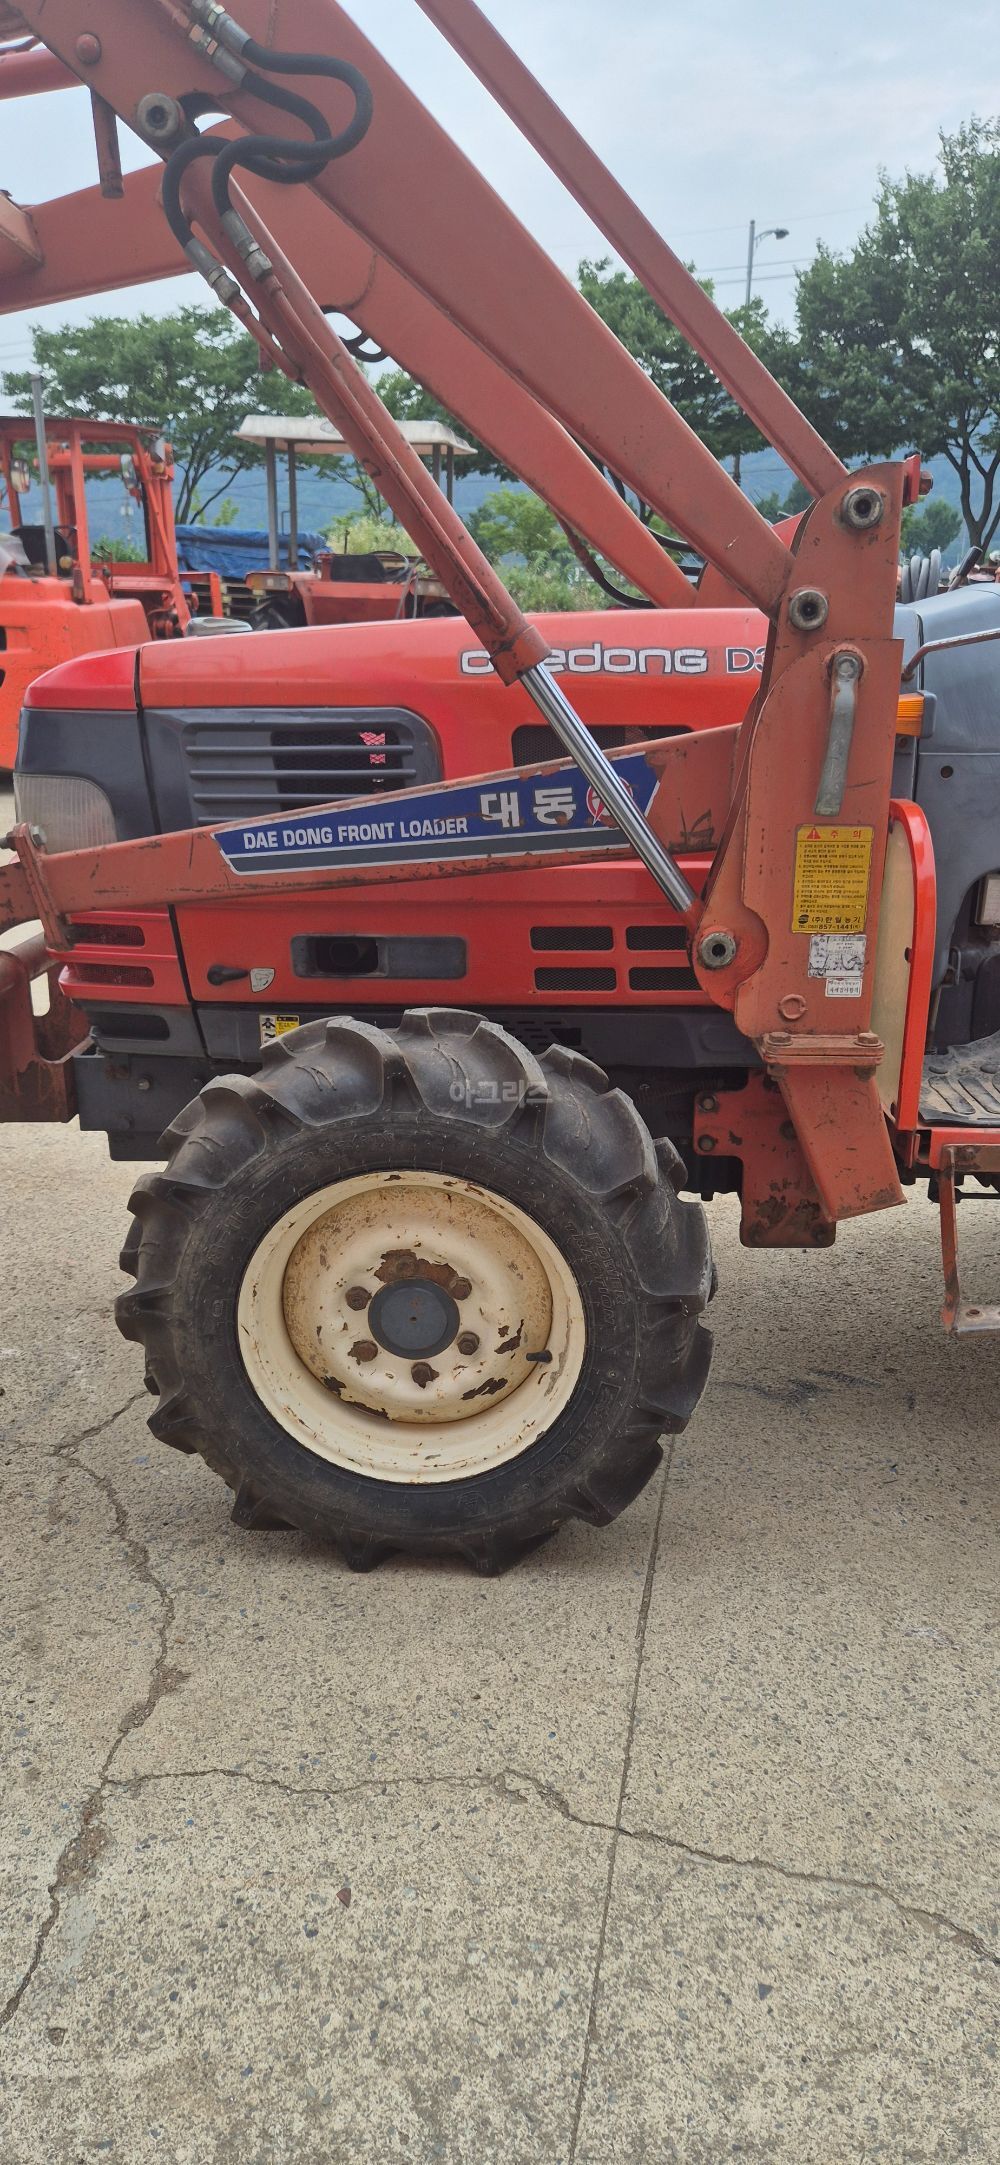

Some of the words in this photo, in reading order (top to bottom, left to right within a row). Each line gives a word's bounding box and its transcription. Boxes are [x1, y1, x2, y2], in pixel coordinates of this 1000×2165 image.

[460, 643, 708, 675] dedong
[243, 831, 279, 850] DAE
[283, 827, 333, 847] DONG
[337, 822, 395, 843] FRONT
[400, 816, 469, 838] LOADER
